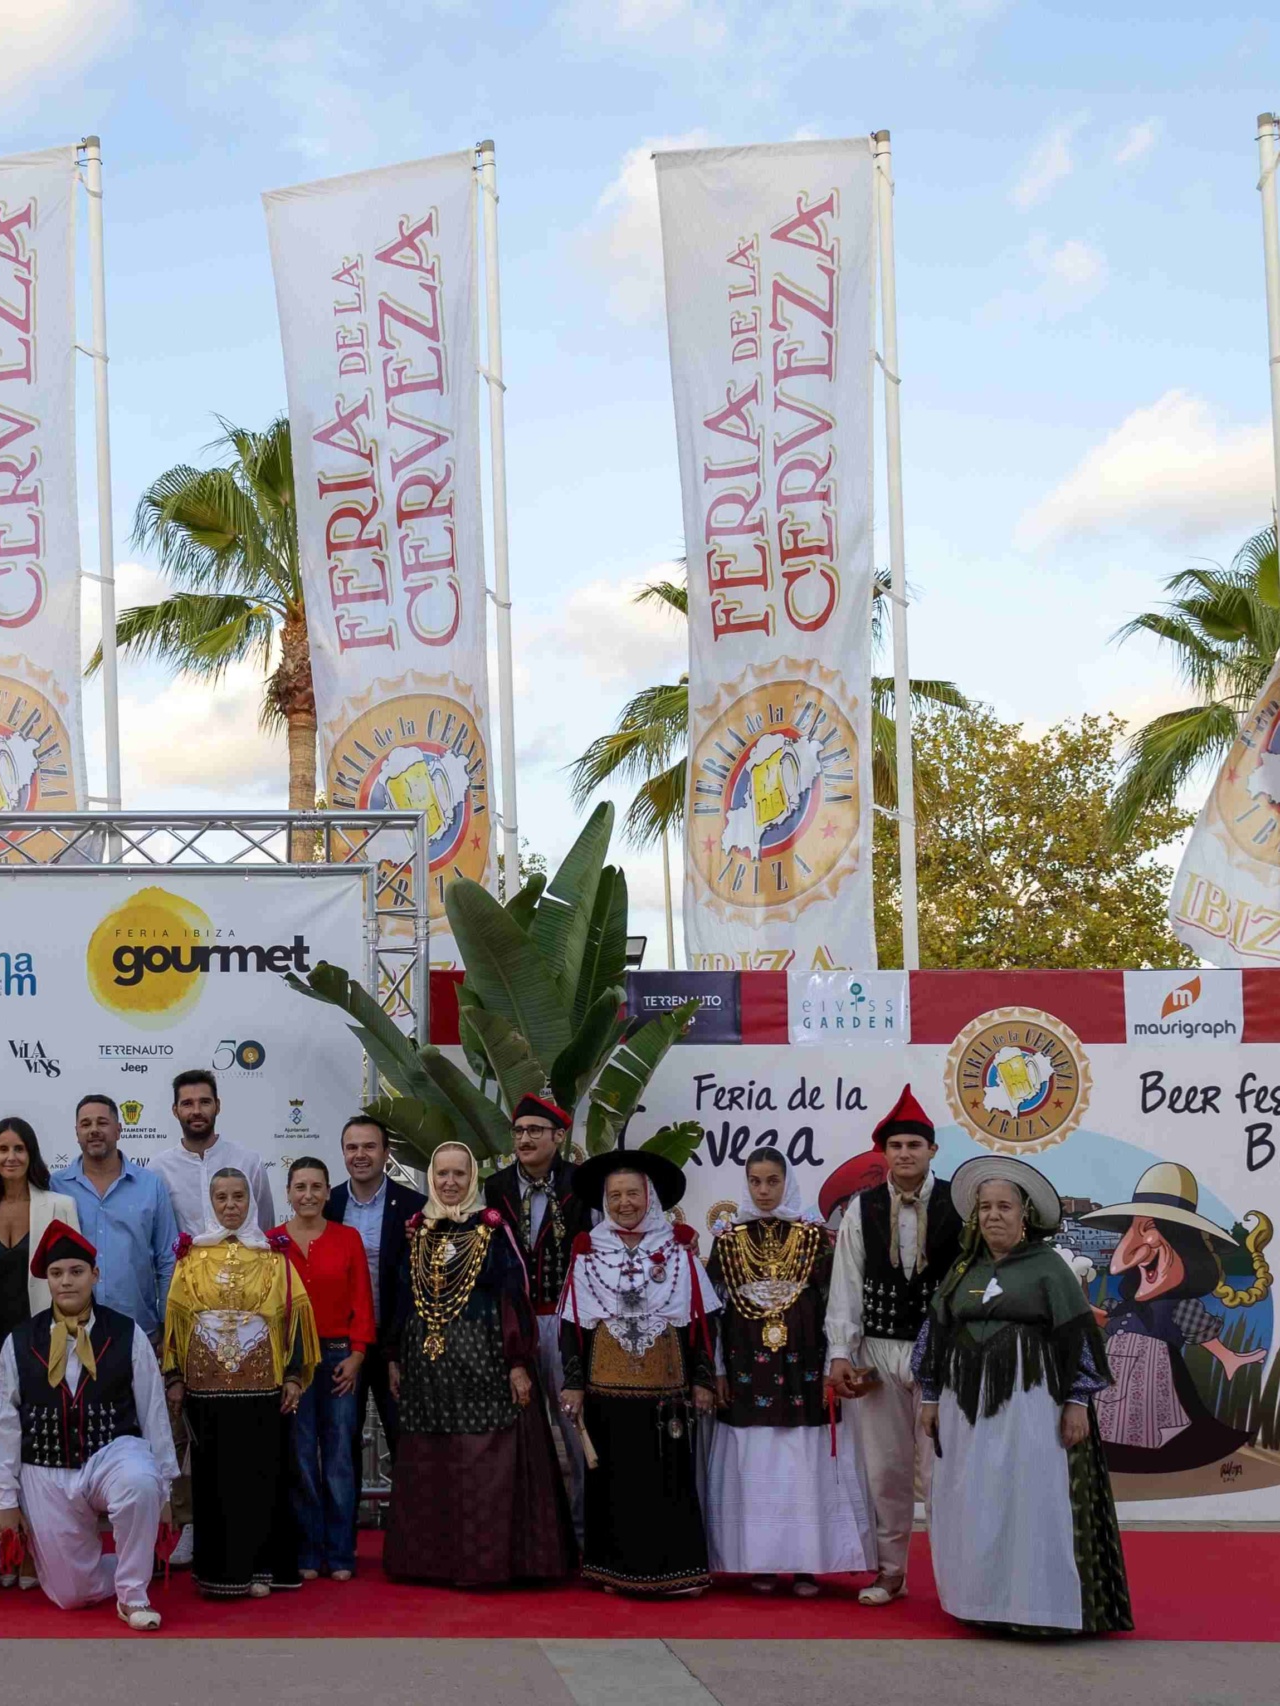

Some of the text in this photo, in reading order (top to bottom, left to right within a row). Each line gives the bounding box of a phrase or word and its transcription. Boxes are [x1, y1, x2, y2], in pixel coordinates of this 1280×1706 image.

[374, 205, 462, 648] CERVEZA
[769, 187, 841, 633] CERVEZA
[702, 232, 778, 642] FERIA DE LA
[312, 253, 401, 655] FERIA DE LA
[373, 724, 395, 748] de
[396, 715, 417, 738] la
[693, 726, 748, 817] FERIA
[743, 713, 763, 737] de
[766, 702, 785, 725] la
[115, 928, 238, 940] FERIA IBIZA
[802, 1016, 894, 1029] GARDEN
[1133, 1019, 1237, 1039] maurigraph
[98, 1045, 174, 1055] TERRENAUTO
[120, 1062, 149, 1074] Jeep
[786, 1073, 826, 1111] de
[835, 1076, 868, 1112] la
[986, 1113, 1051, 1137] IBIZA
